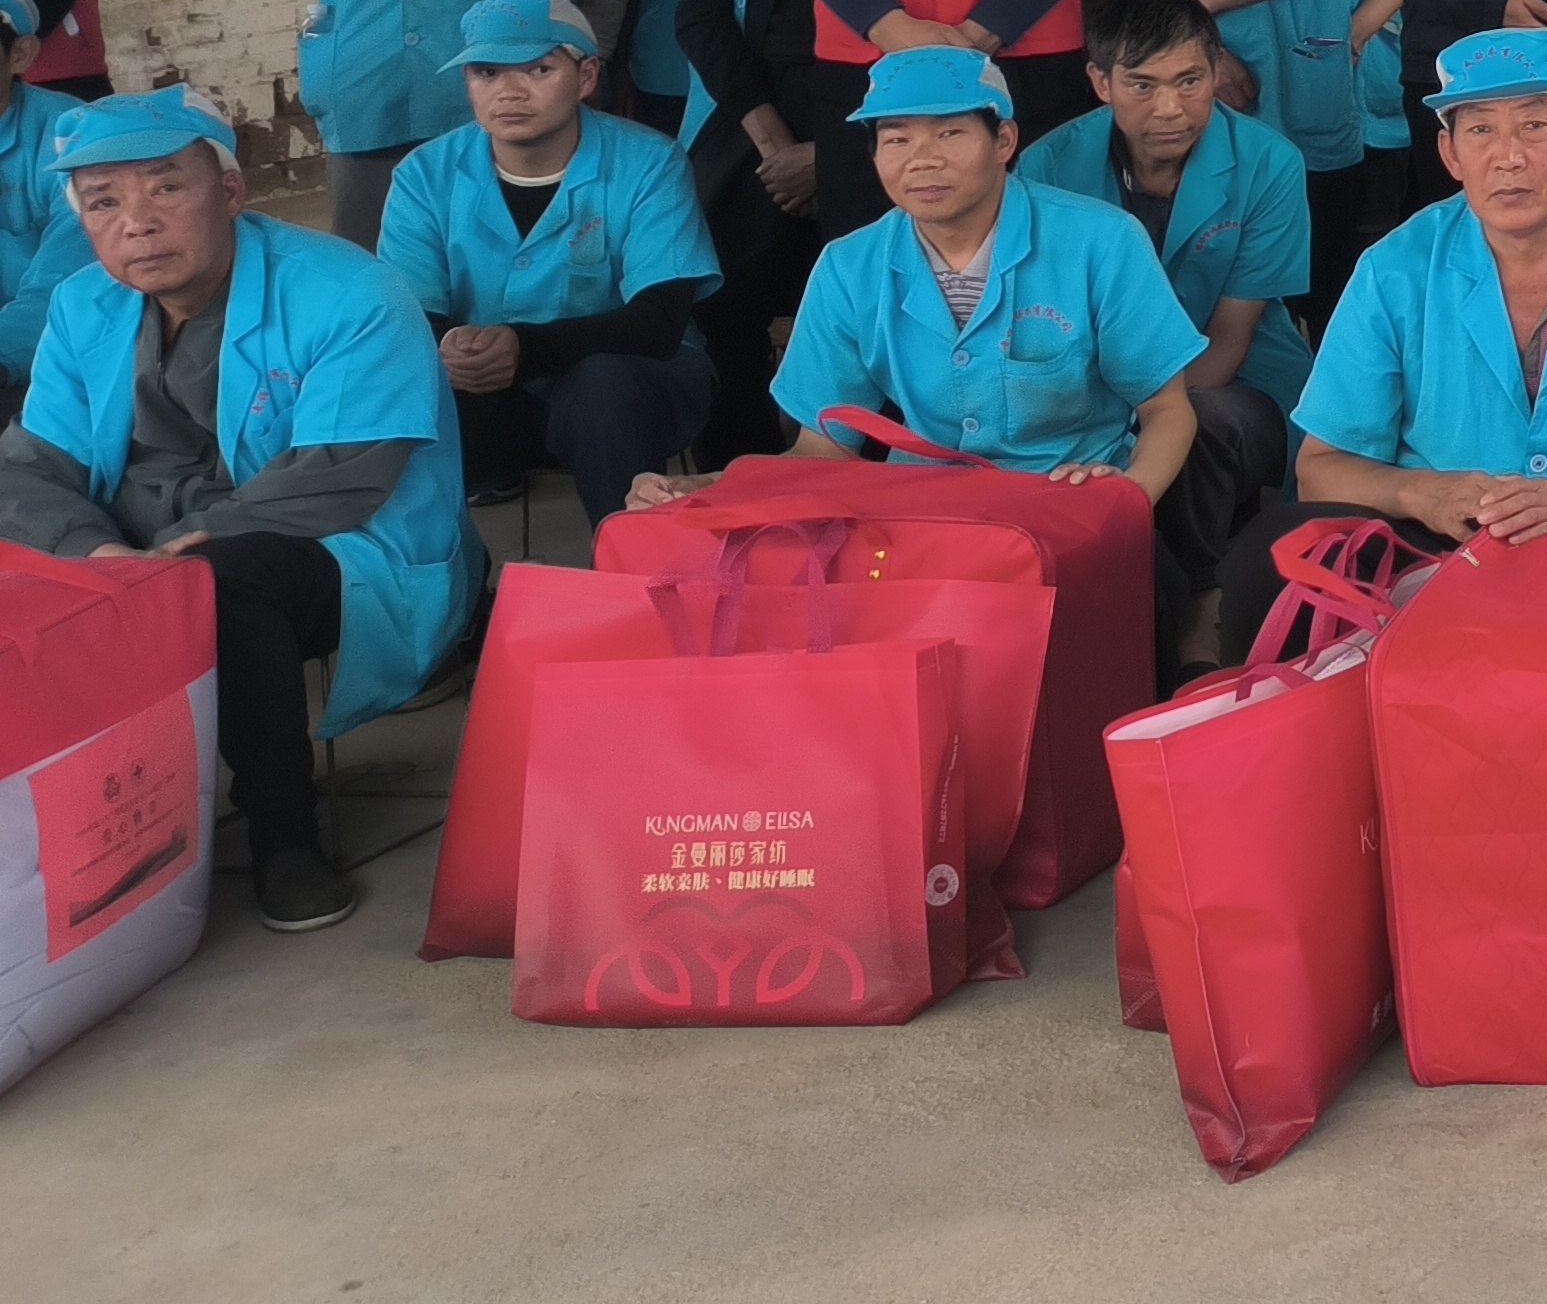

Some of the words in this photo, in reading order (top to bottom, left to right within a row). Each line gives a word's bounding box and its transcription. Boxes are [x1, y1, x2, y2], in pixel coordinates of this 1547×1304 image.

[645, 813, 738, 836] KINGMAN
[765, 810, 814, 831] ELISA
[671, 839, 787, 869] 金曼丽莎家纺
